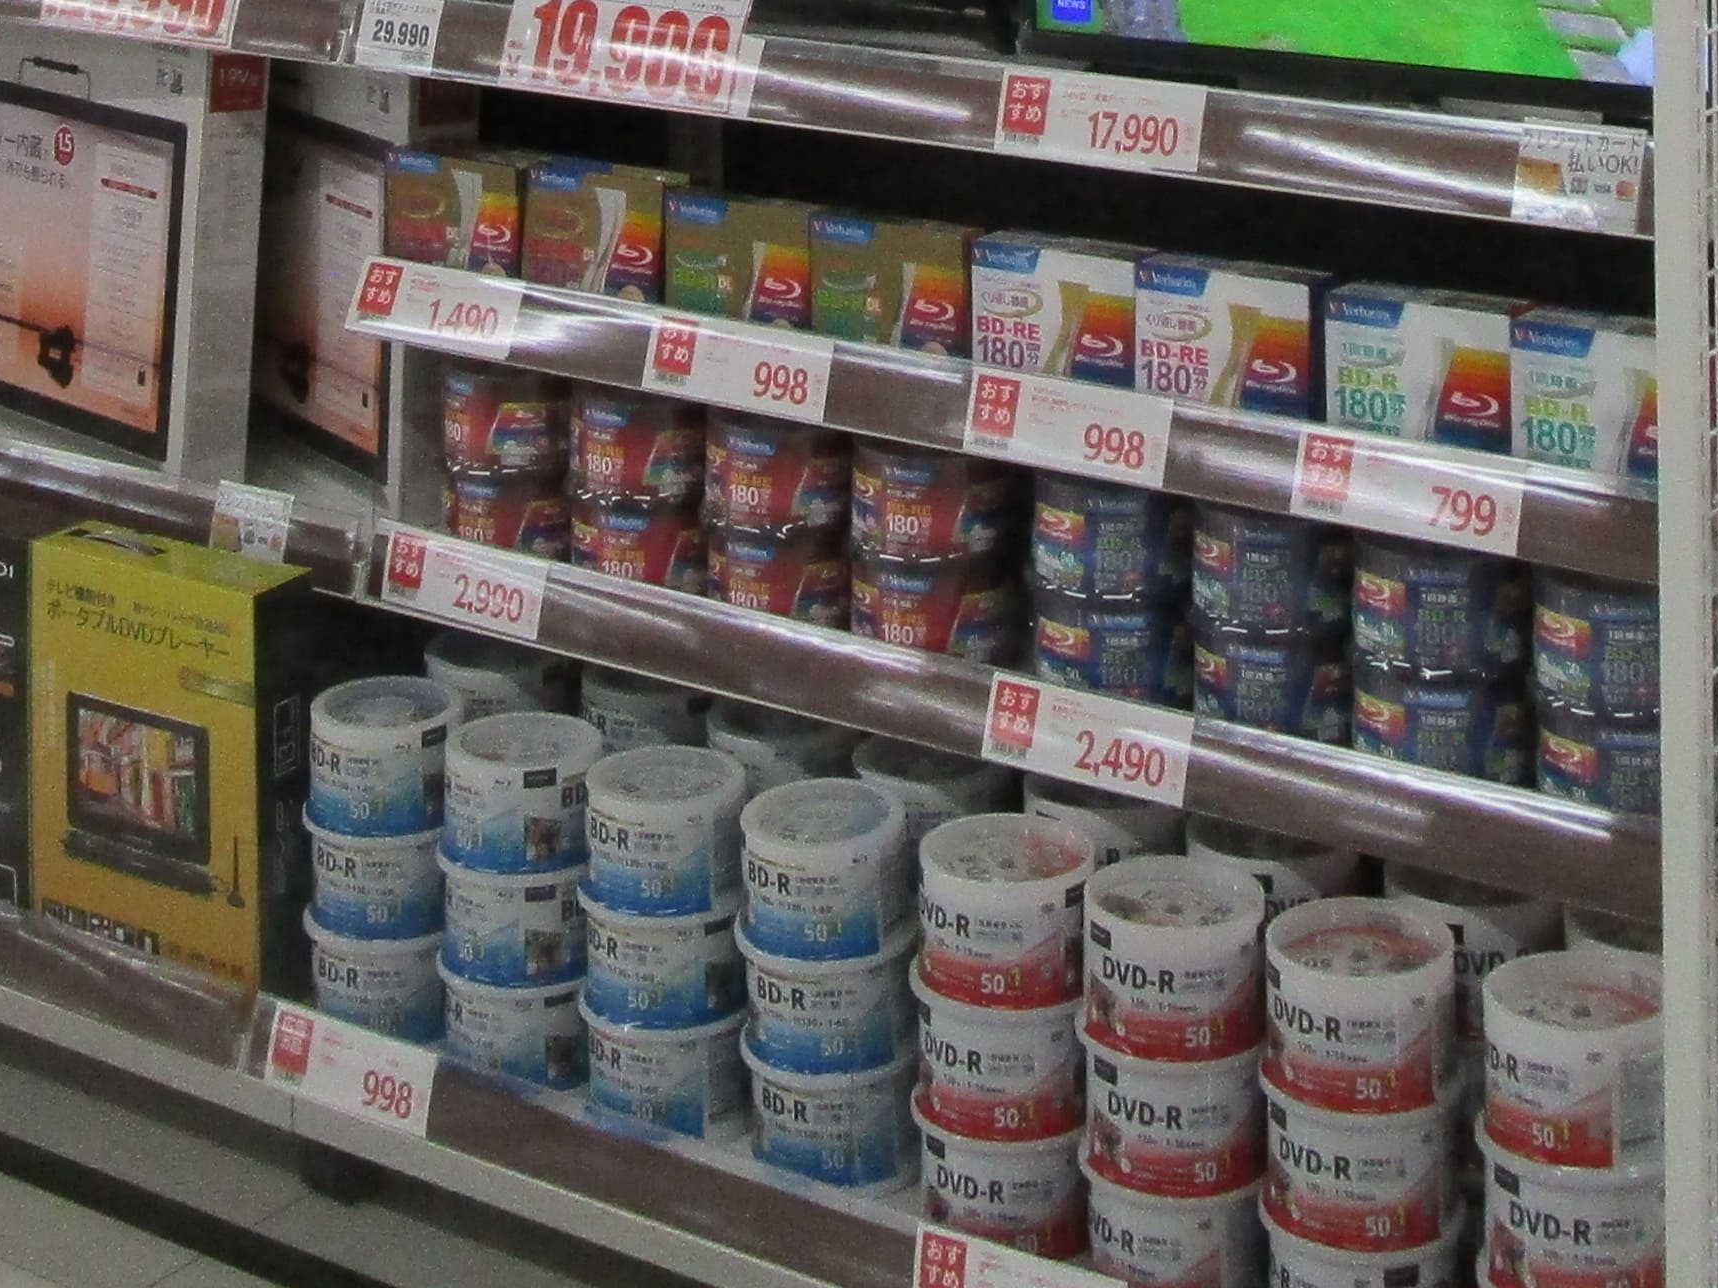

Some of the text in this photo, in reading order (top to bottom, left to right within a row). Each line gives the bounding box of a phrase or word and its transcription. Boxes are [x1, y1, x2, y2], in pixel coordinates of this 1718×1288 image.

[1087, 110, 1179, 157] 17,990
[976, 315, 1041, 341] BD-RE
[1140, 339, 1210, 367] BD-RE
[753, 360, 810, 406] 998
[1083, 423, 1145, 470] 998
[1430, 486, 1497, 537] 799
[1074, 730, 1166, 789] 2,490
[317, 851, 358, 880] BD-R
[747, 862, 792, 897] BD-R
[318, 959, 360, 990] BD-R
[757, 976, 807, 1012] BD-R
[1101, 955, 1176, 994] DVD-R
[1273, 997, 1343, 1043] DVD-R
[362, 1071, 413, 1120] 998
[762, 1089, 810, 1123] BD-R
[1107, 1091, 1183, 1131] DVD-R
[1278, 1138, 1352, 1182] DVD-R
[936, 1164, 1005, 1205] DVD-R
[1509, 1201, 1592, 1245] DVD-R
